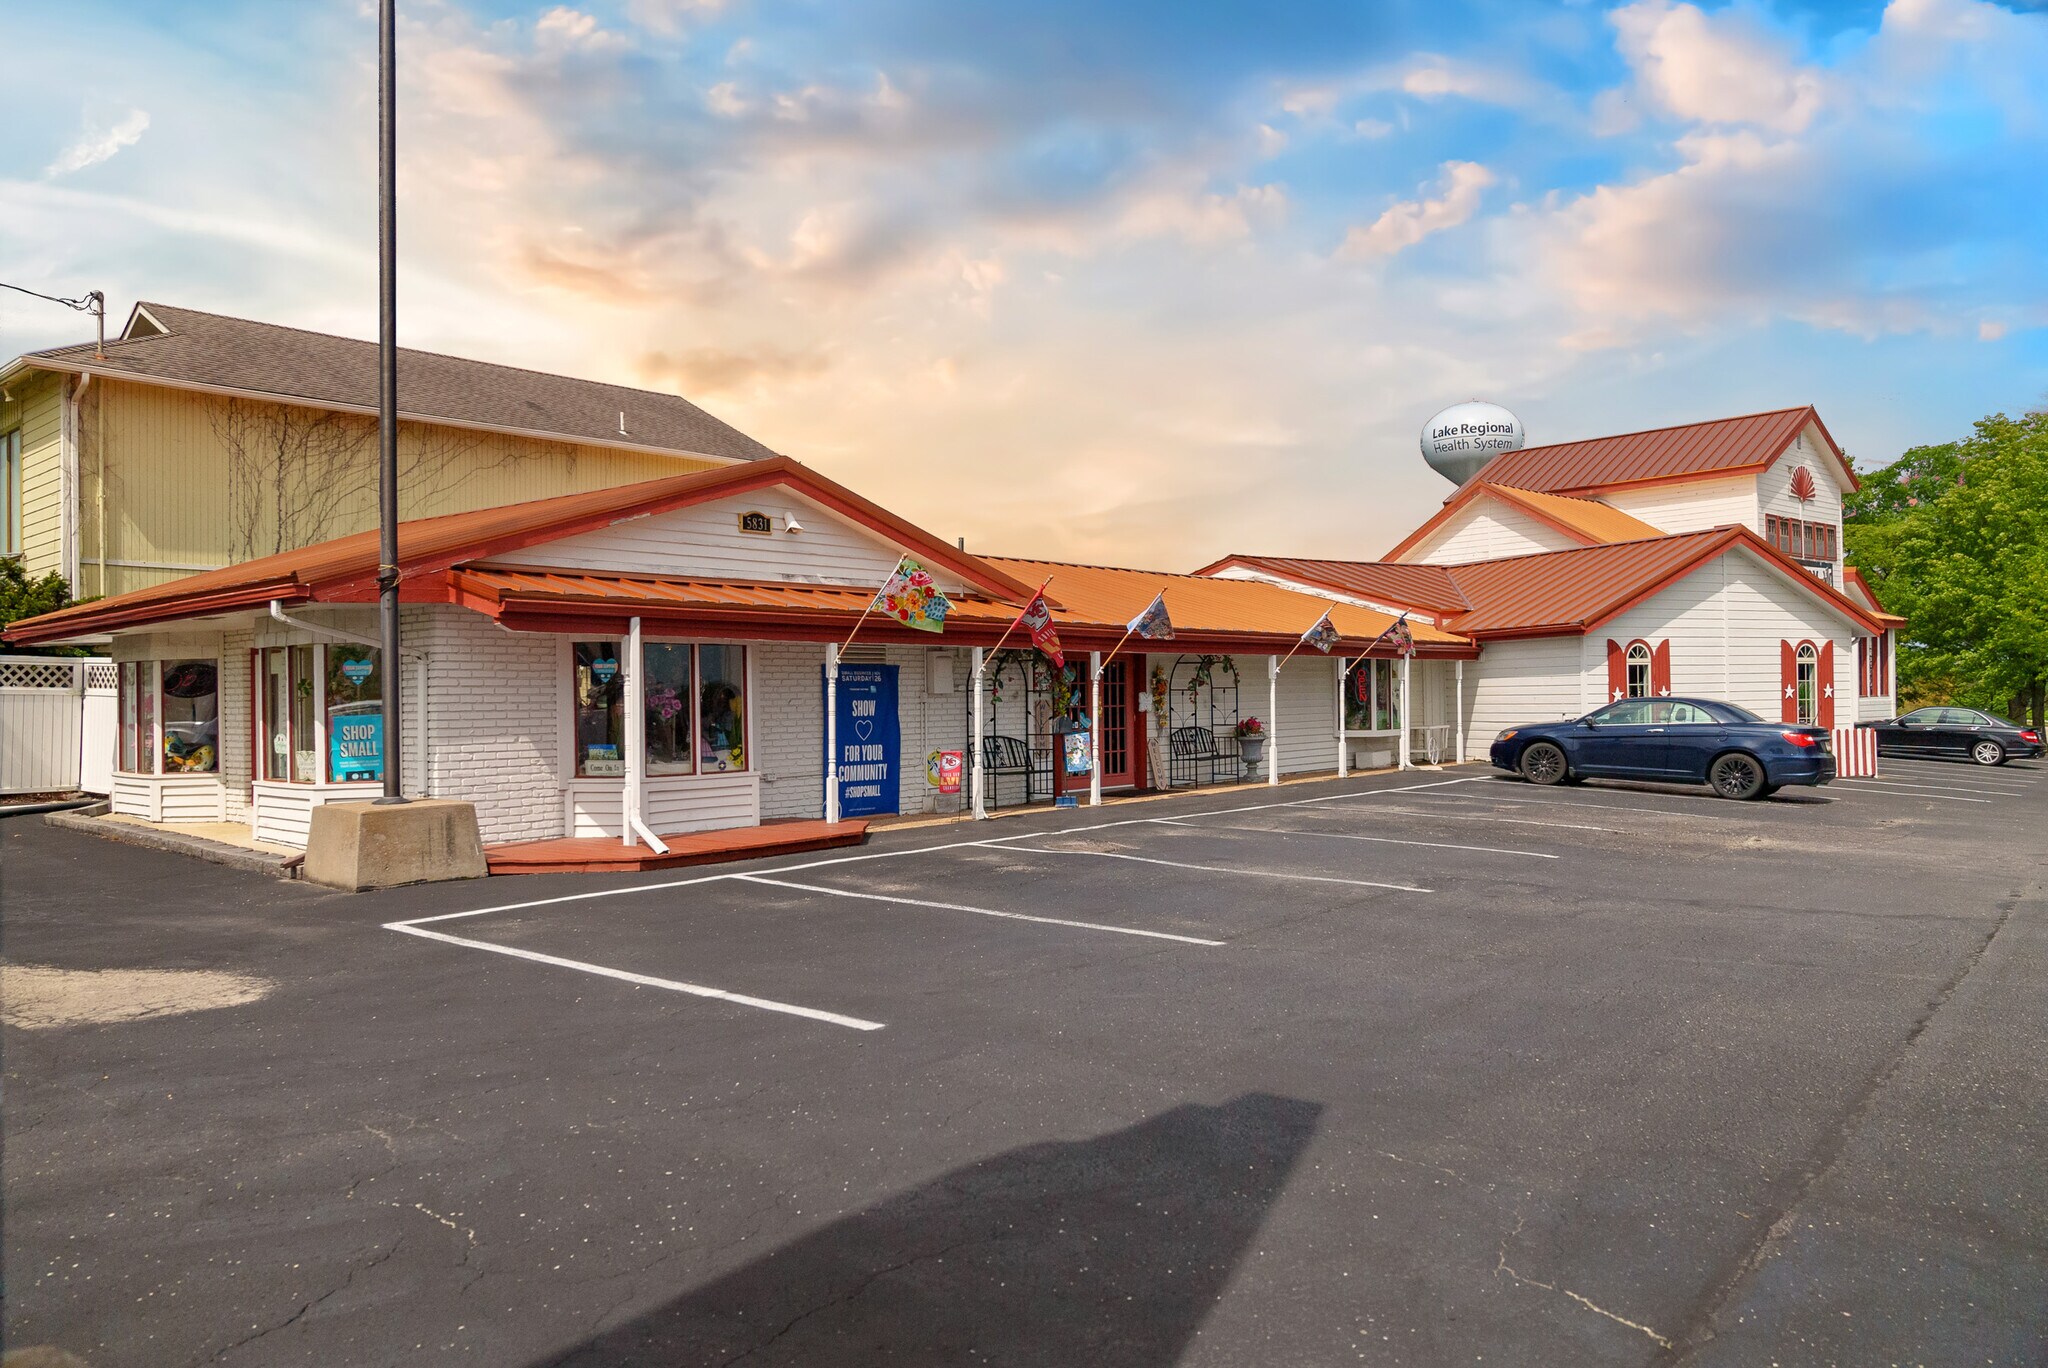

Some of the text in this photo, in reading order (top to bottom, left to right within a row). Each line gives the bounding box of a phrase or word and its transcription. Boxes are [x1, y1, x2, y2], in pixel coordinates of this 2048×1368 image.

[1432, 422, 1514, 439] Lake Regional
[1433, 439, 1470, 453] Health
[1474, 438, 1513, 451] System
[746, 517, 768, 530] 5831
[1357, 669, 1367, 702] OPEN
[852, 700, 876, 717] SHOW
[342, 724, 375, 740] SHOP
[340, 741, 379, 758] SMALL
[844, 744, 883, 762] FOR YOUR
[838, 763, 888, 782] COMMUNITY
[1151, 741, 1165, 788] WELCOME
[844, 785, 881, 799] #SHOPSMALL
